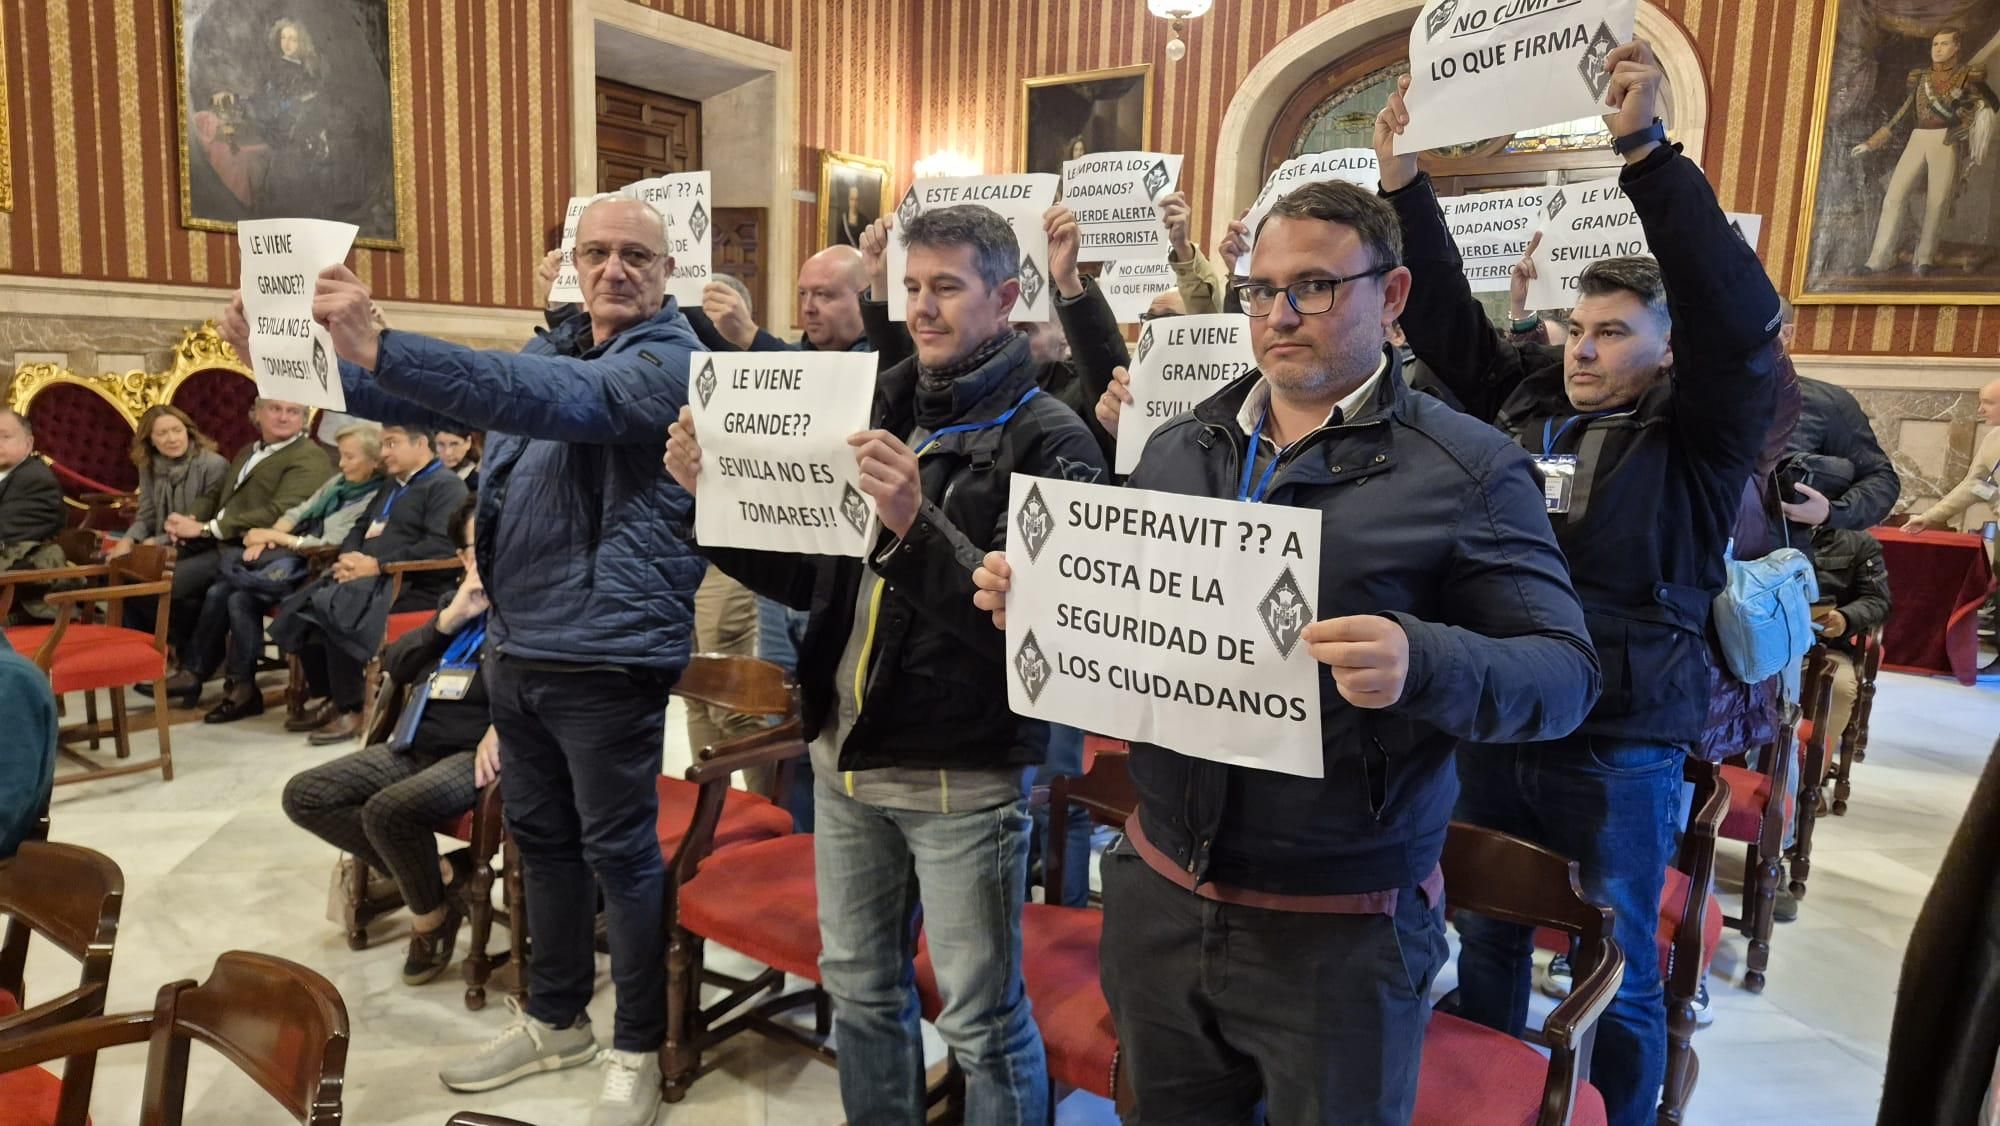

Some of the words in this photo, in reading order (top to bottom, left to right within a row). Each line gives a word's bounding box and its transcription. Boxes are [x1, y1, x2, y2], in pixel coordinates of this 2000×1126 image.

[1453, 9, 1487, 34] NO
[1431, 57, 1457, 81] LO
[1463, 44, 1507, 74] QUE
[1514, 23, 1589, 61] FIRMA
[1127, 159, 1151, 171] LOS
[1279, 163, 1306, 181] ESTE
[1310, 157, 1377, 174] ALCALDE
[677, 182, 691, 198] ??
[695, 183, 704, 196] A
[926, 186, 960, 203] ESTE
[962, 184, 1033, 201] ALCALDE
[1581, 190, 1598, 204] LE
[1603, 187, 1626, 200] VIE
[1112, 206, 1156, 221] ALERTA
[1455, 198, 1514, 215] IMPORTA
[1518, 195, 1543, 208] LOS
[250, 236, 263, 255] LE
[264, 234, 293, 254] VIENE
[675, 239, 688, 252] DE
[1080, 230, 1159, 245] TITERRORISTA
[1550, 243, 1611, 263] SEVILLA
[1616, 240, 1642, 256] NO
[1119, 265, 1132, 275] NO
[1134, 263, 1169, 275] CUMPLE
[257, 274, 305, 295] GRANDE??
[1110, 285, 1120, 294] LO
[1123, 284, 1141, 295] QUE
[1143, 283, 1170, 293] FIRMA
[258, 316, 286, 336] SEVILLA
[286, 319, 299, 337] NO
[300, 319, 311, 338] ES
[1168, 329, 1185, 345] LE
[1190, 327, 1239, 345] VIENE
[262, 357, 312, 380] TOMARES!!
[1162, 362, 1249, 381] GRANDE??
[732, 369, 749, 389] LE
[754, 369, 803, 390] VIENE
[724, 412, 811, 437] GRANDE??
[719, 455, 776, 481] SEVILLA
[777, 461, 805, 483] NO
[809, 463, 834, 484] ES
[738, 501, 838, 528] TOMARES!!
[1068, 500, 1228, 548] SUPERAVIT
[1237, 521, 1272, 554] ??
[1281, 531, 1304, 560] A
[1058, 553, 1140, 591] COSTA
[1149, 567, 1182, 598] DE
[1191, 575, 1225, 606] LA
[1056, 602, 1207, 656] SEGURIDAD
[1217, 635, 1255, 665] DE
[1058, 652, 1101, 683] LOS
[1108, 664, 1308, 722] CIUDADANOS
